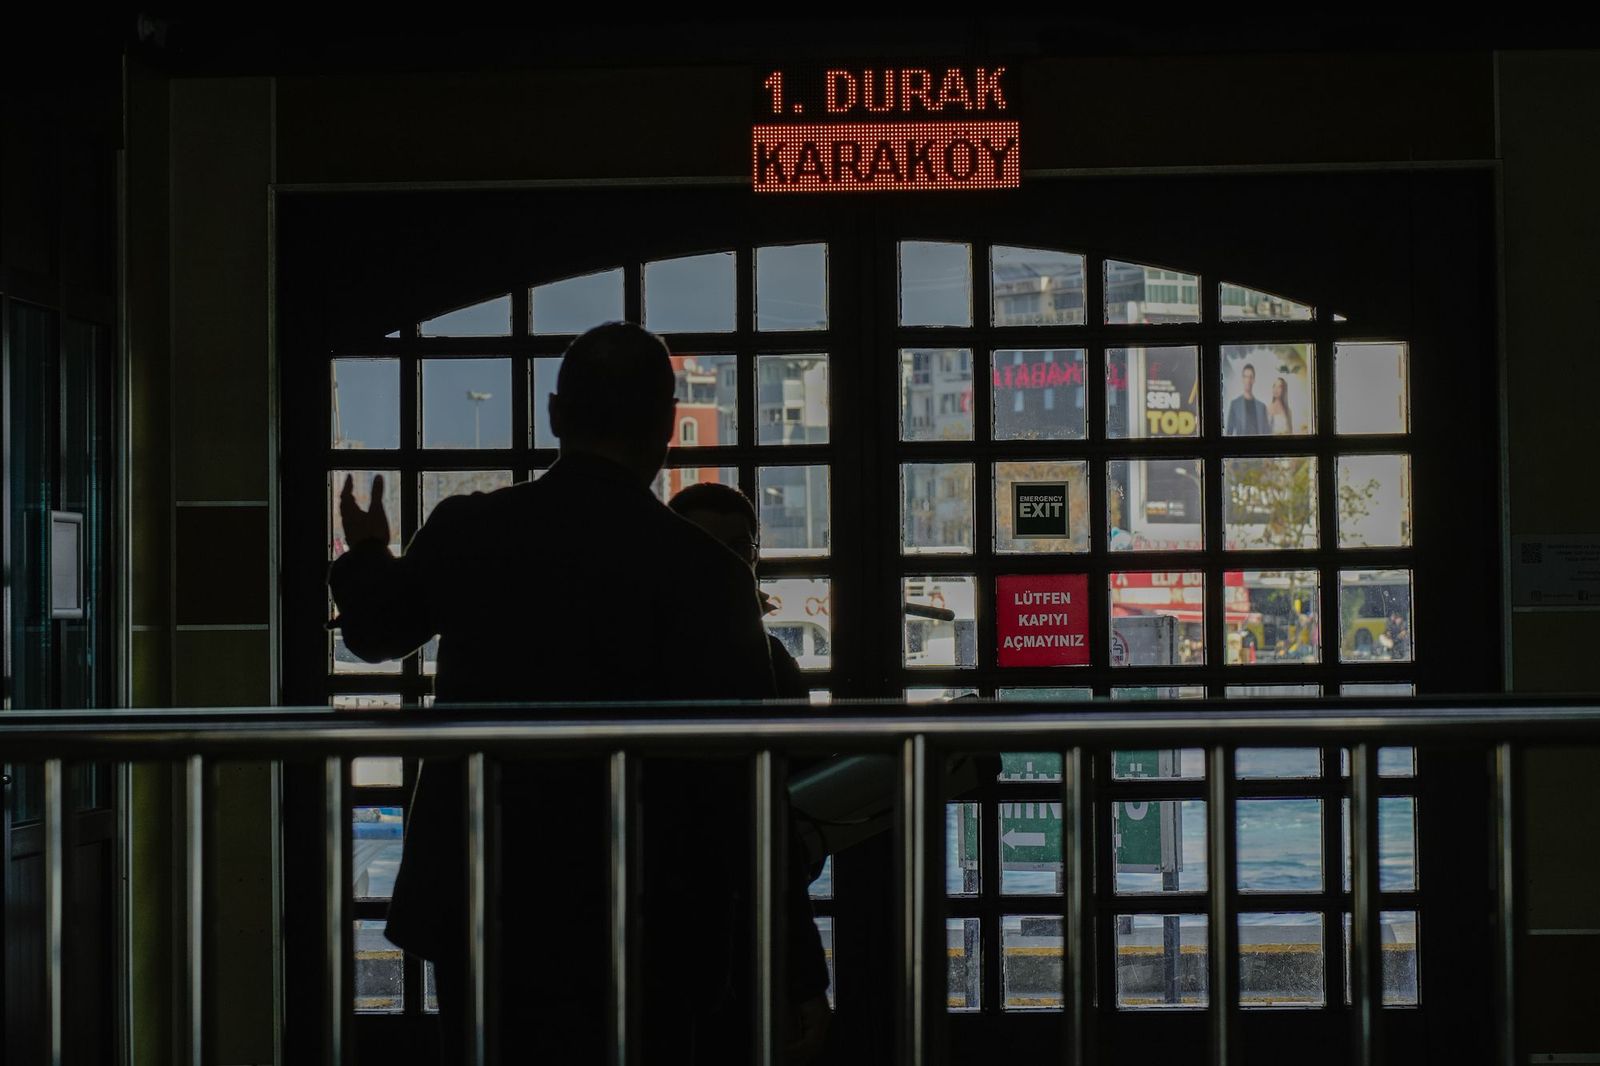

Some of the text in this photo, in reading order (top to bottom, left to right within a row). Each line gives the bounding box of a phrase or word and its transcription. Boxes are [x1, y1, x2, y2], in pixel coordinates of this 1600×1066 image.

[764, 68, 1006, 114] 1. DURAK
[1146, 410, 1197, 435] TOD
[1019, 502, 1063, 518] EXIT
[1014, 590, 1071, 605] LÜTFEN
[1018, 613, 1068, 626] KAPIYI
[1003, 634, 1084, 651] AÇMAYINIZ
